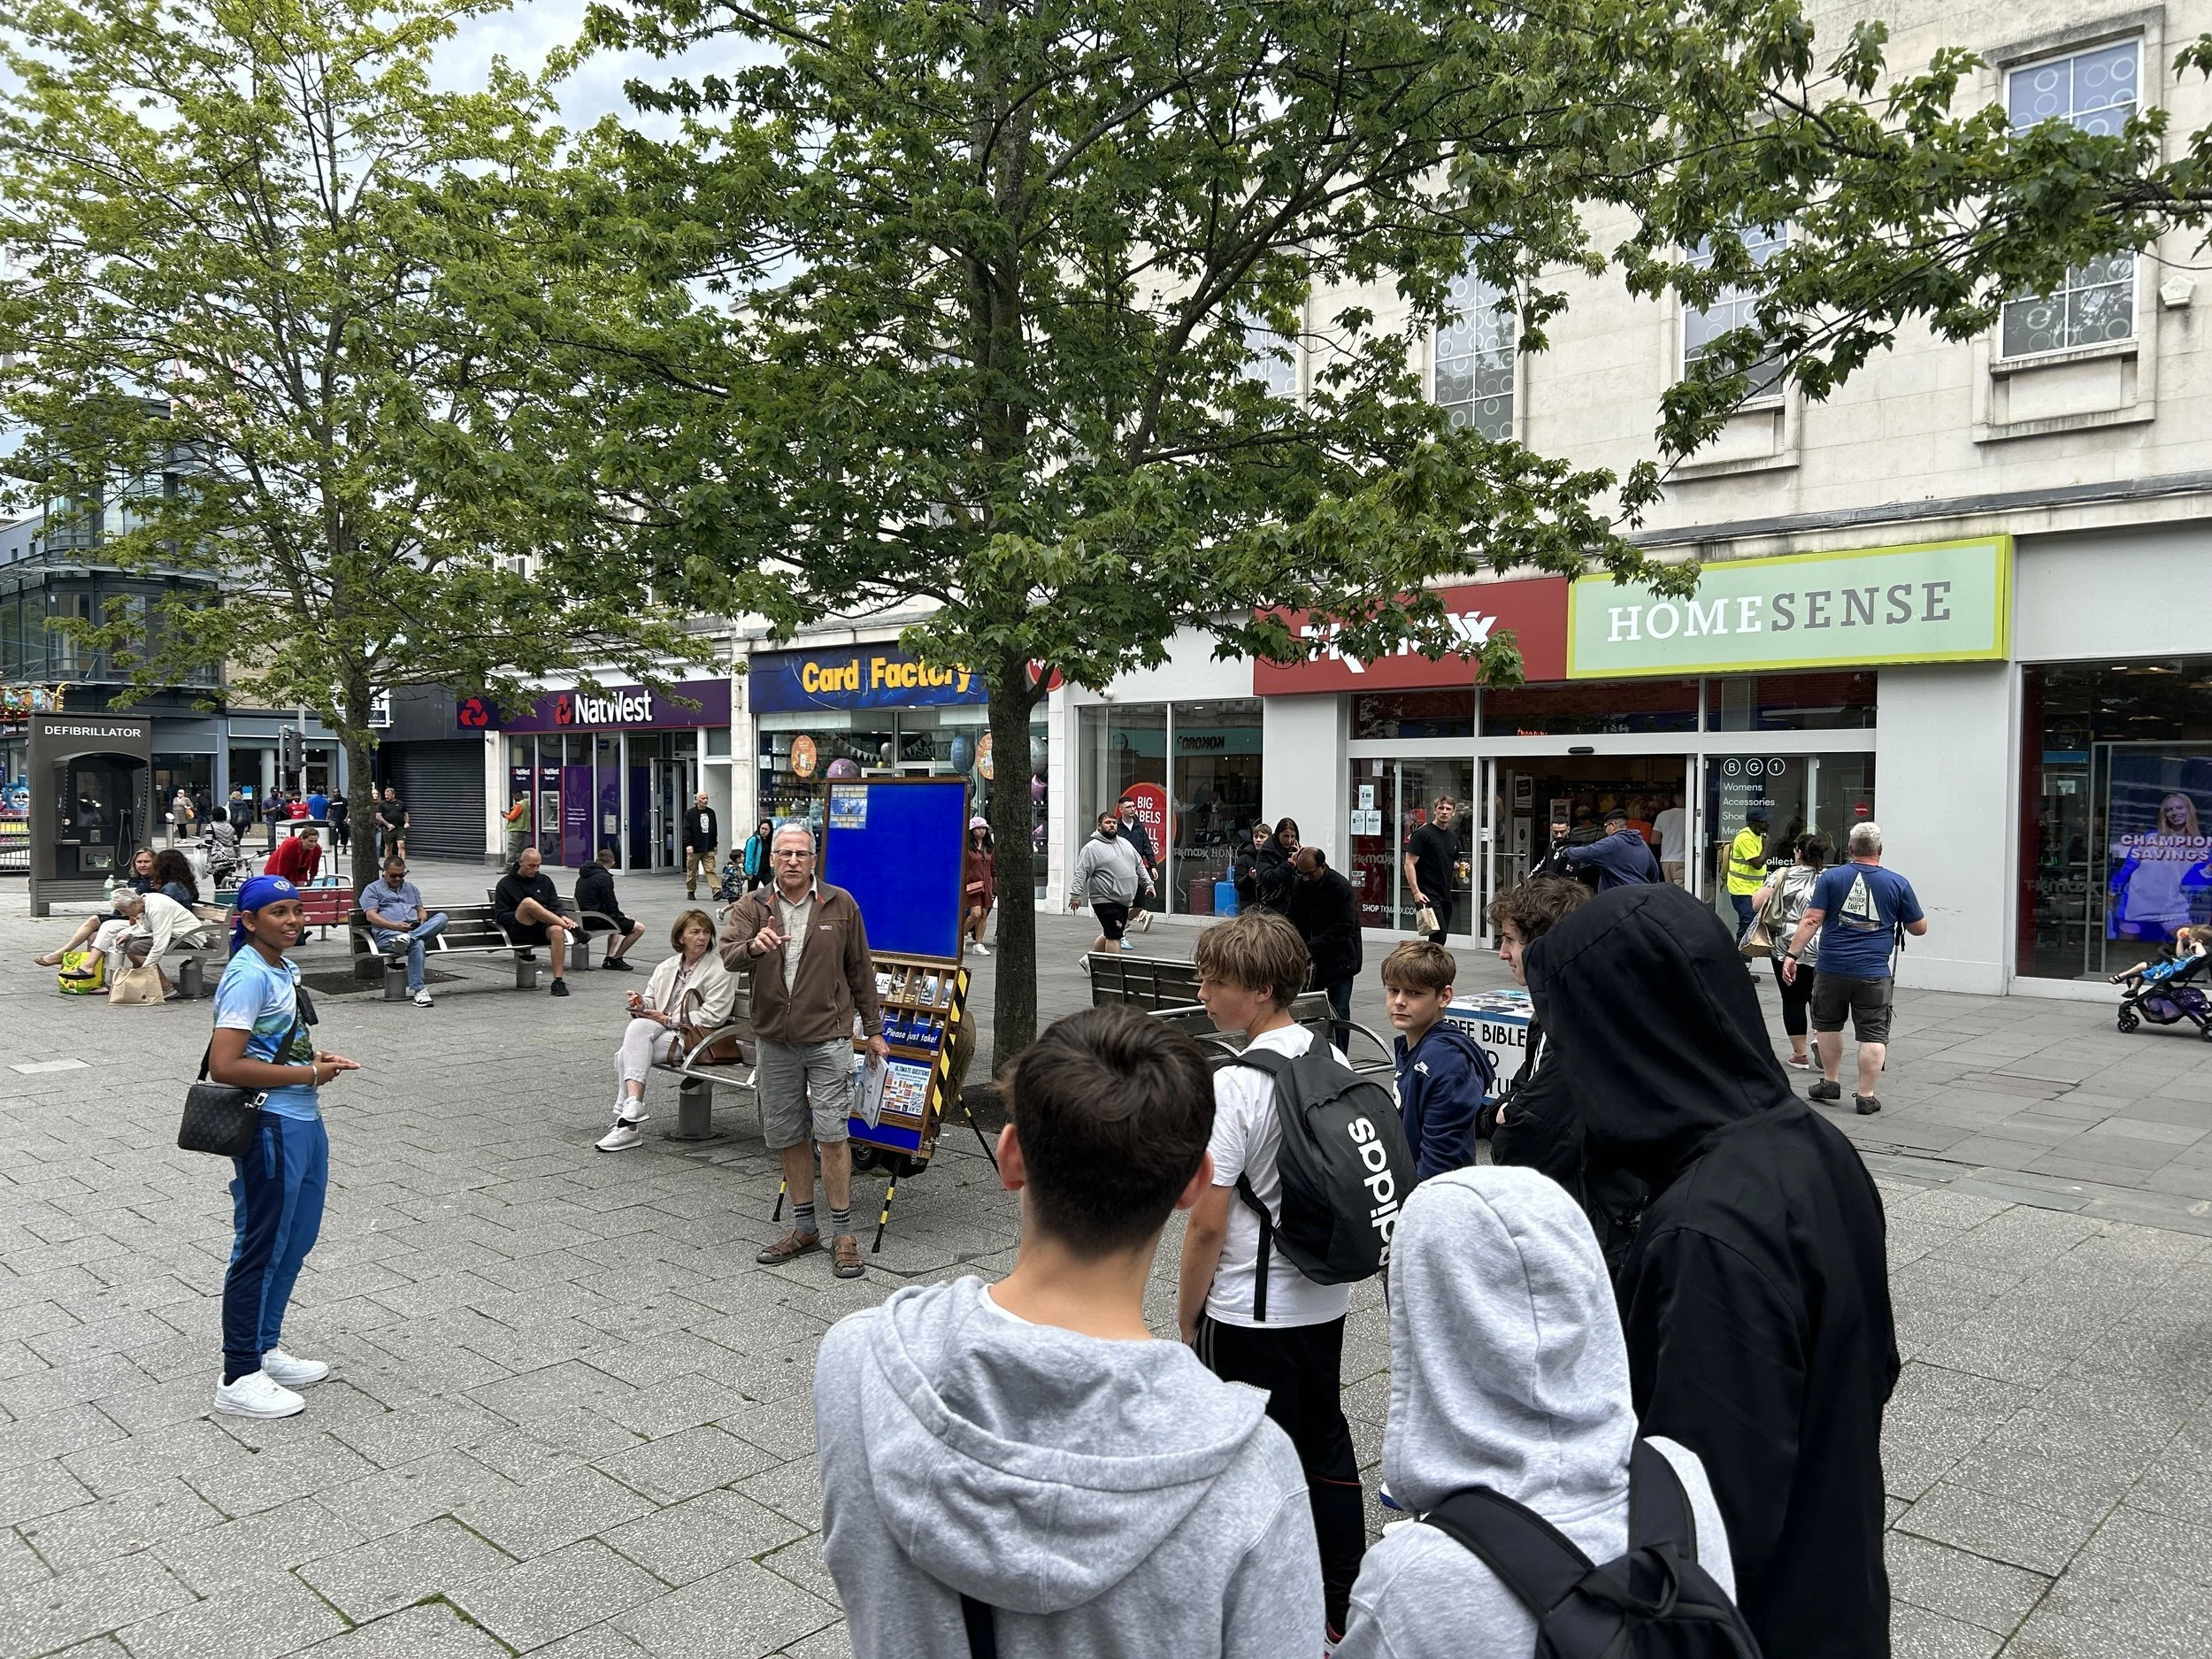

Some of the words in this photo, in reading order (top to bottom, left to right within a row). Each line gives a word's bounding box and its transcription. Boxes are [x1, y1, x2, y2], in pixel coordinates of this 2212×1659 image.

[1607, 580, 1951, 643] HOMESENSE
[802, 659, 860, 693] Card
[871, 656, 972, 693] Factory
[575, 689, 653, 724] NatWest
[44, 726, 142, 737] DEFIBRILLATOR
[1137, 796, 1153, 810] BIG
[1722, 797, 1776, 806] Accessories
[1722, 811, 1747, 820] Shoe
[1766, 856, 1794, 865] ollect
[2131, 849, 2209, 861] SAVINGS
[906, 1032, 920, 1041] just
[920, 1033, 938, 1044] take!
[1482, 1024, 1526, 1048] BIBLE
